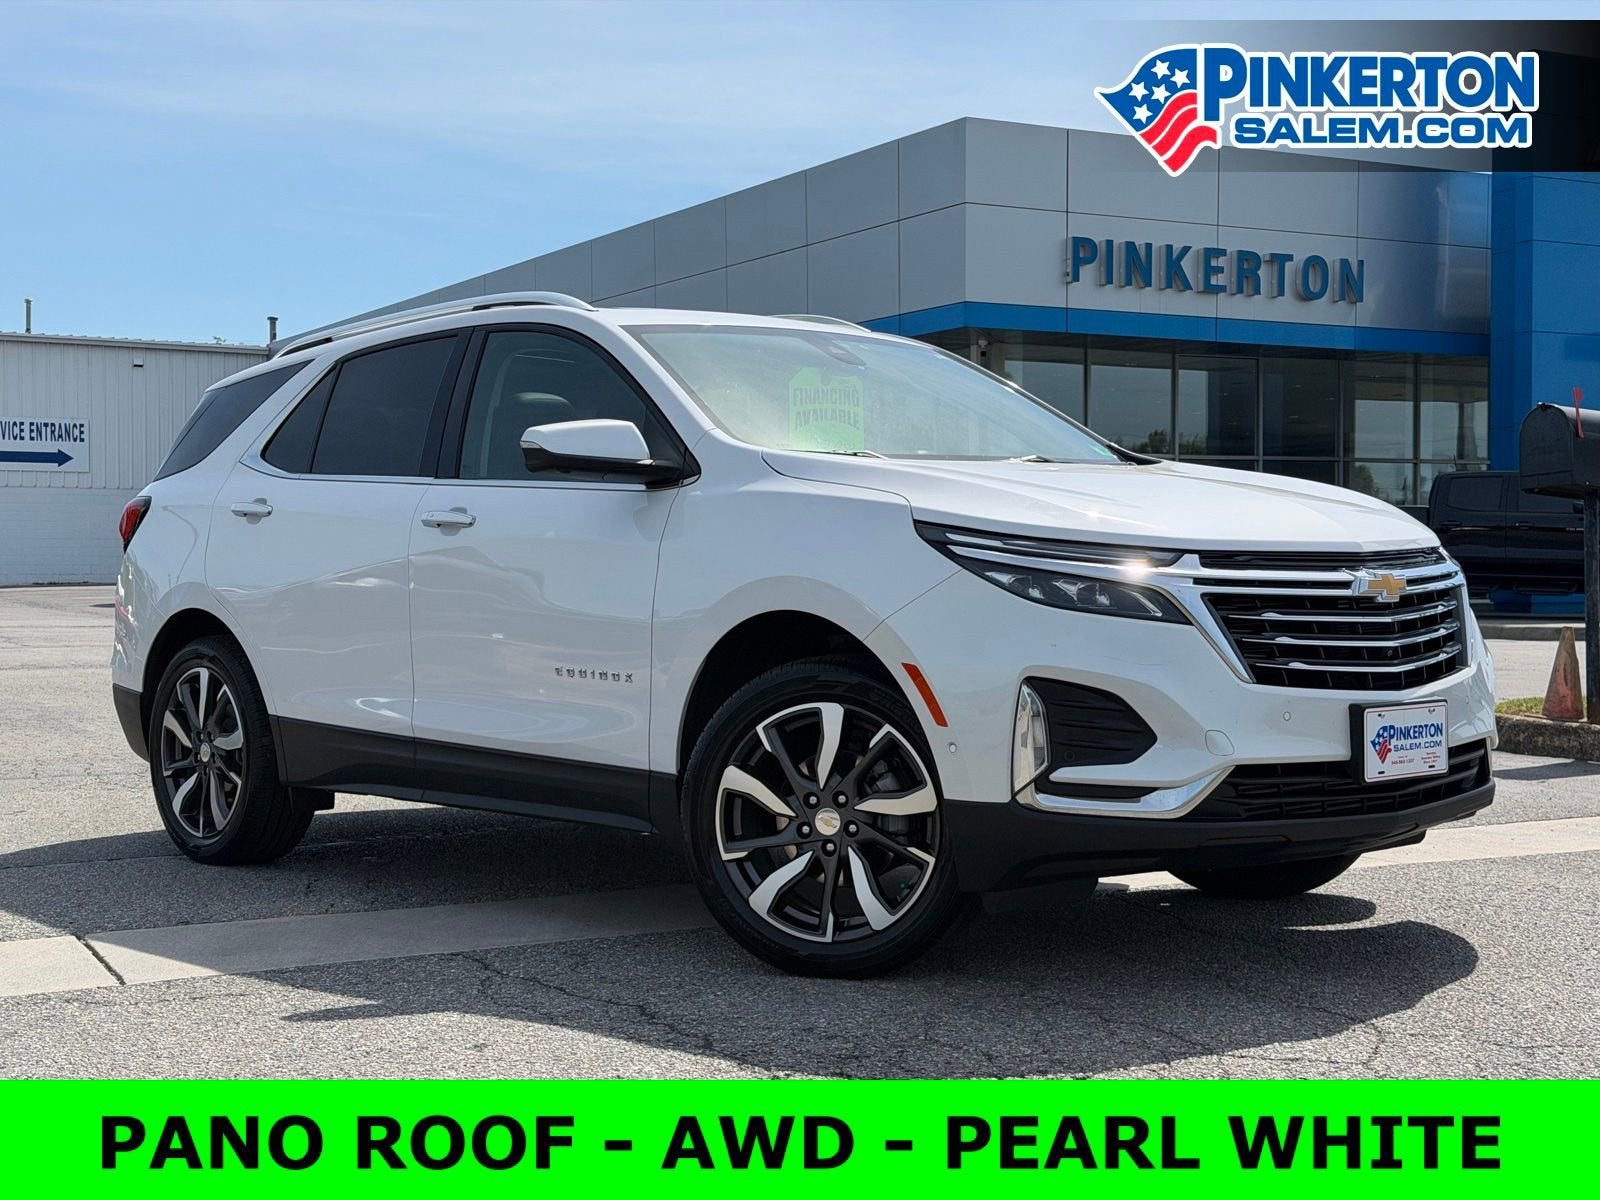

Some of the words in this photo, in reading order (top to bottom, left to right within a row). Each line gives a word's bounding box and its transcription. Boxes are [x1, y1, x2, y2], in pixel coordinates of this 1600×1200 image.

[1067, 236, 1365, 304] PINKERTON
[792, 387, 860, 408] FINANCING
[794, 407, 861, 430] AVAILABLE
[29, 421, 85, 442] ENTRANCE
[554, 667, 634, 683] EQUINOX
[1388, 722, 1443, 746] PINKERTON
[1393, 741, 1442, 752] SALEM.COM
